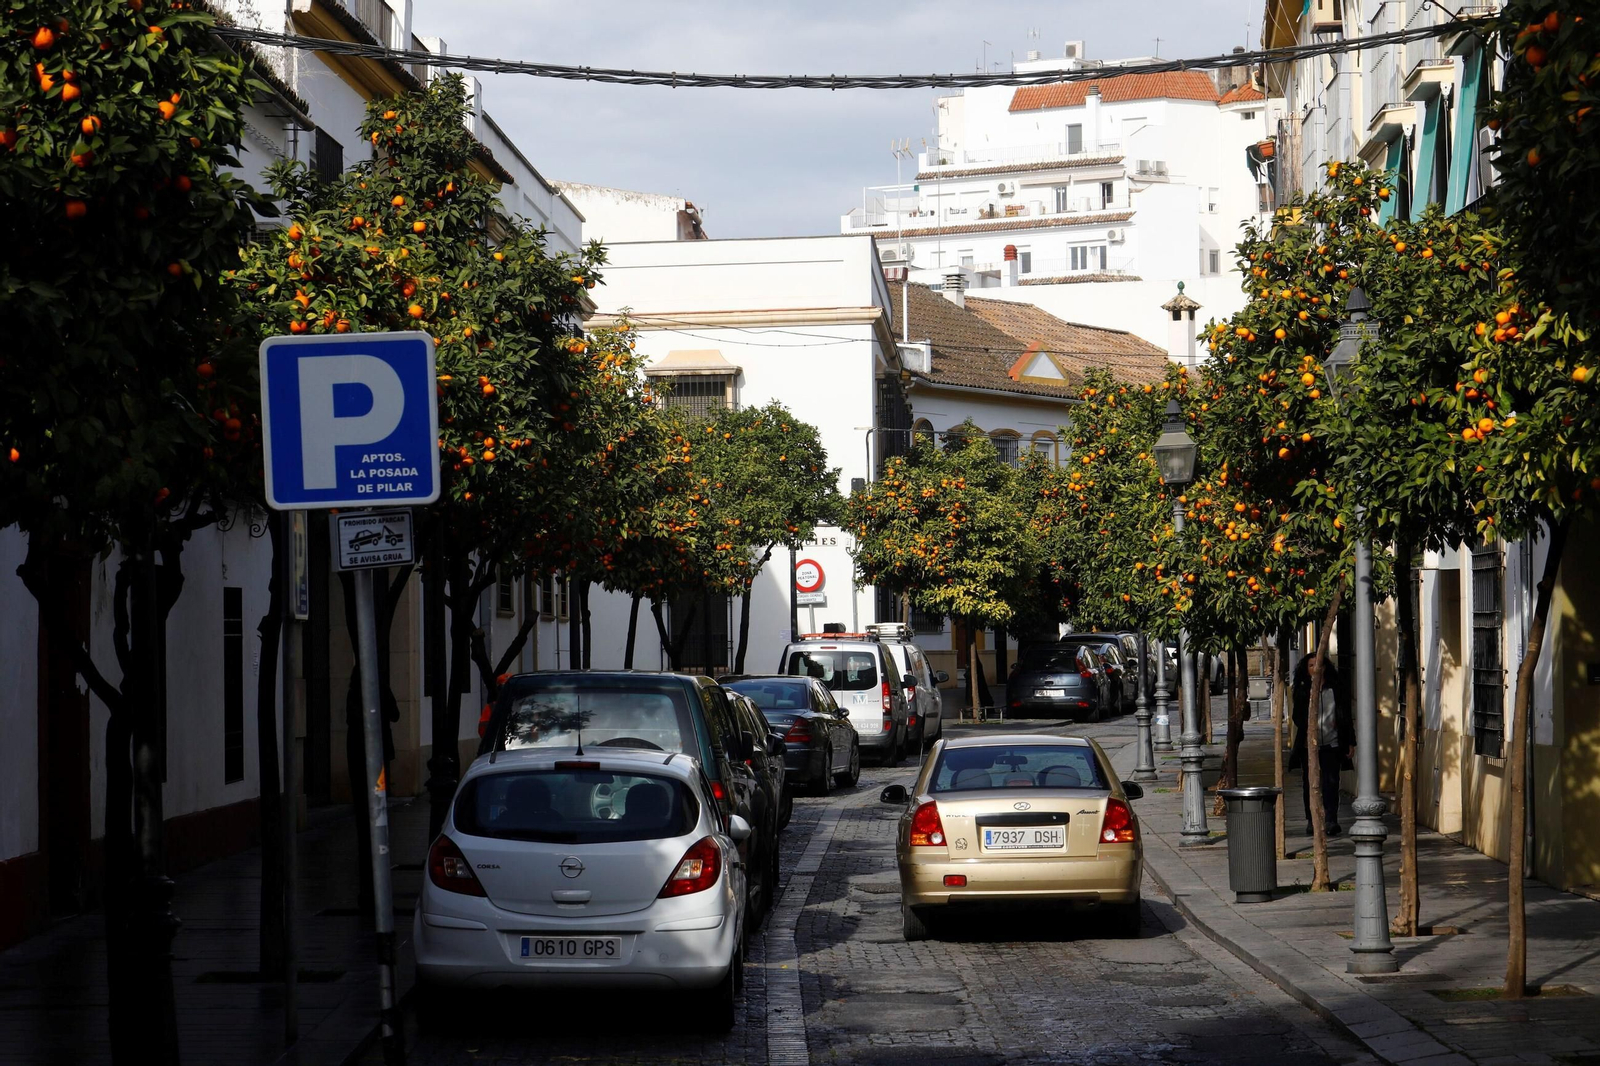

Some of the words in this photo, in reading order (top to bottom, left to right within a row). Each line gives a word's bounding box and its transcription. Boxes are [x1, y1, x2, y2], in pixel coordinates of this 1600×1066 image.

[298, 354, 405, 490] P
[362, 453, 405, 463] APTOS.
[350, 470, 366, 478] LA
[369, 467, 418, 478] POSADA
[357, 484, 374, 493] DE
[377, 482, 413, 492] PILAR
[344, 518, 377, 527] PROHIBIDO
[378, 516, 405, 524] APARCAR
[349, 556, 358, 565] SE
[360, 555, 381, 564] AVISA
[383, 553, 403, 561] GRUA
[993, 831, 1025, 844] 7937
[1034, 831, 1059, 843] DSH
[534, 940, 577, 956] 0610
[583, 940, 615, 956] GPS
